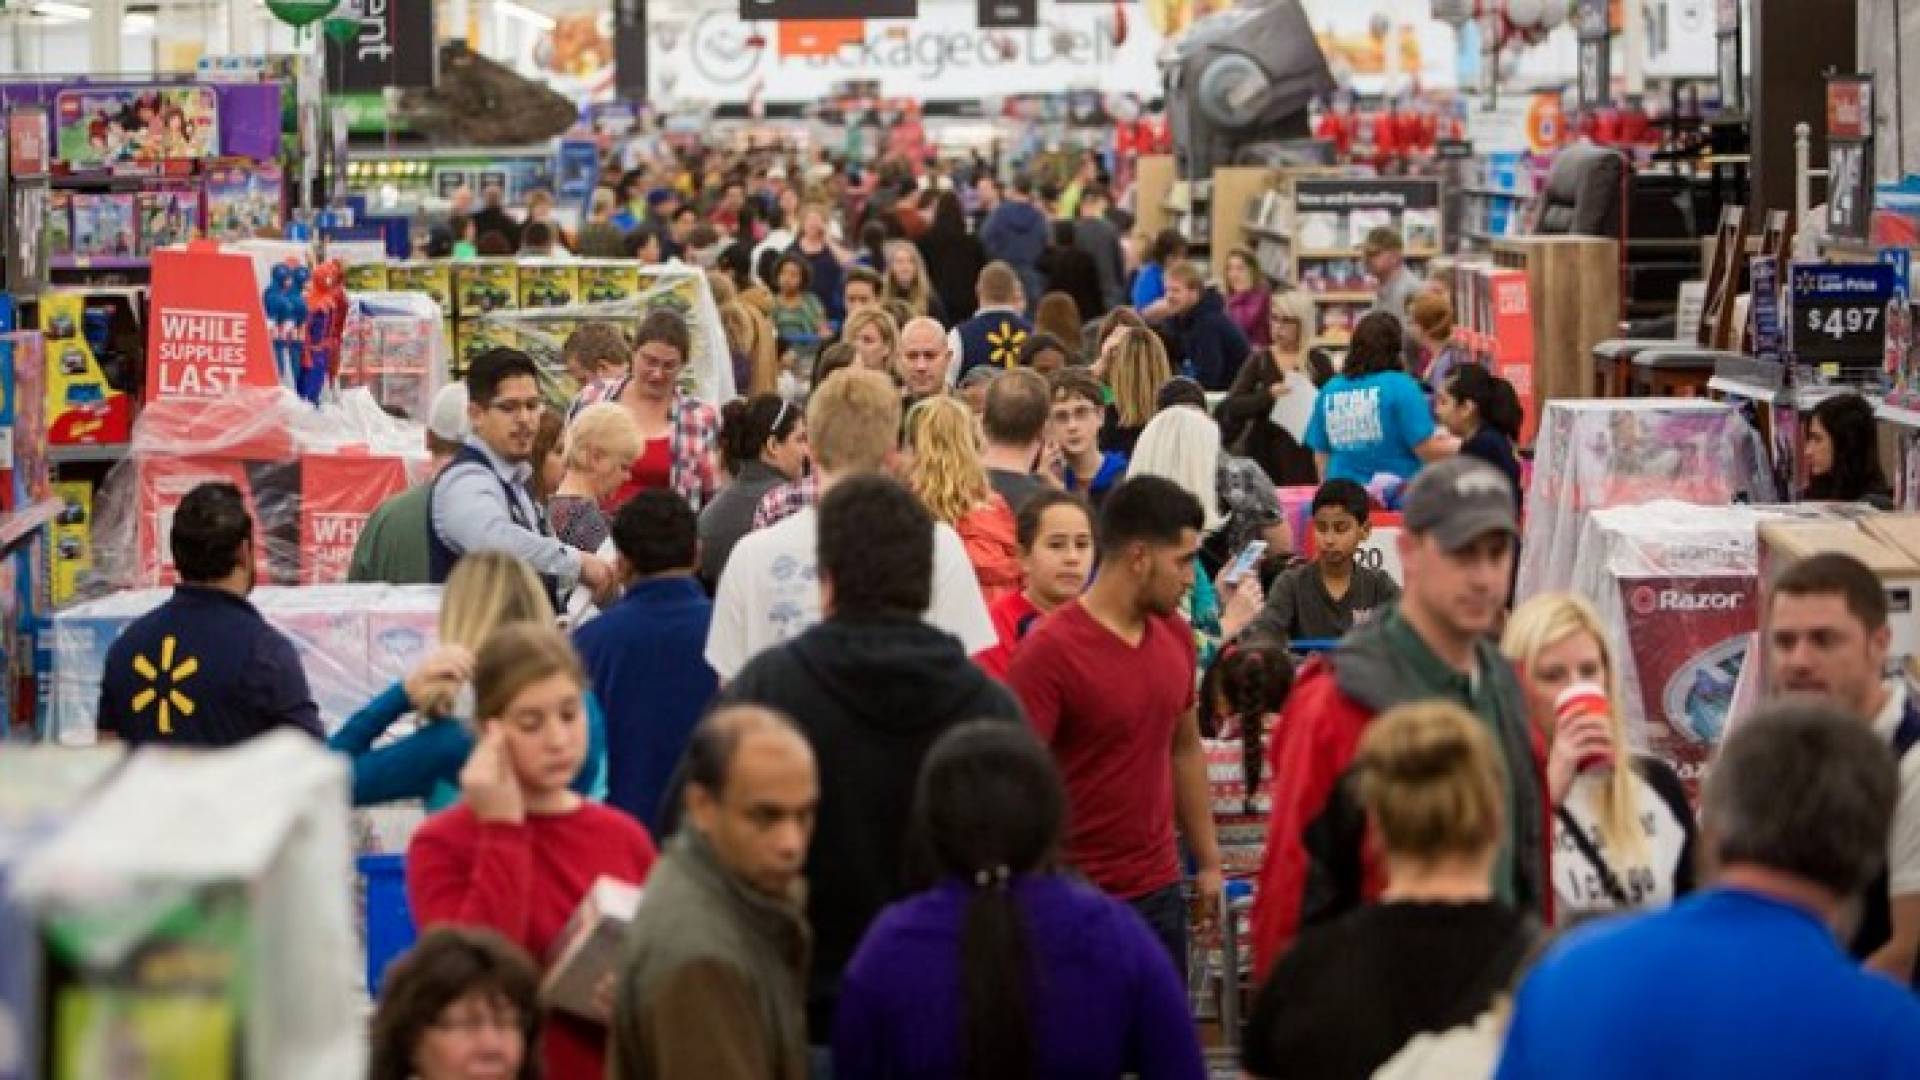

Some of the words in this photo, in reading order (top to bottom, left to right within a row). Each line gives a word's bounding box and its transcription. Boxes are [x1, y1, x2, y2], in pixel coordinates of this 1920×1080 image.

[161, 315, 247, 343] WHILE
[159, 342, 247, 363] SUPPLIES
[159, 362, 247, 395] LAST
[1660, 589, 1745, 610] Razor
